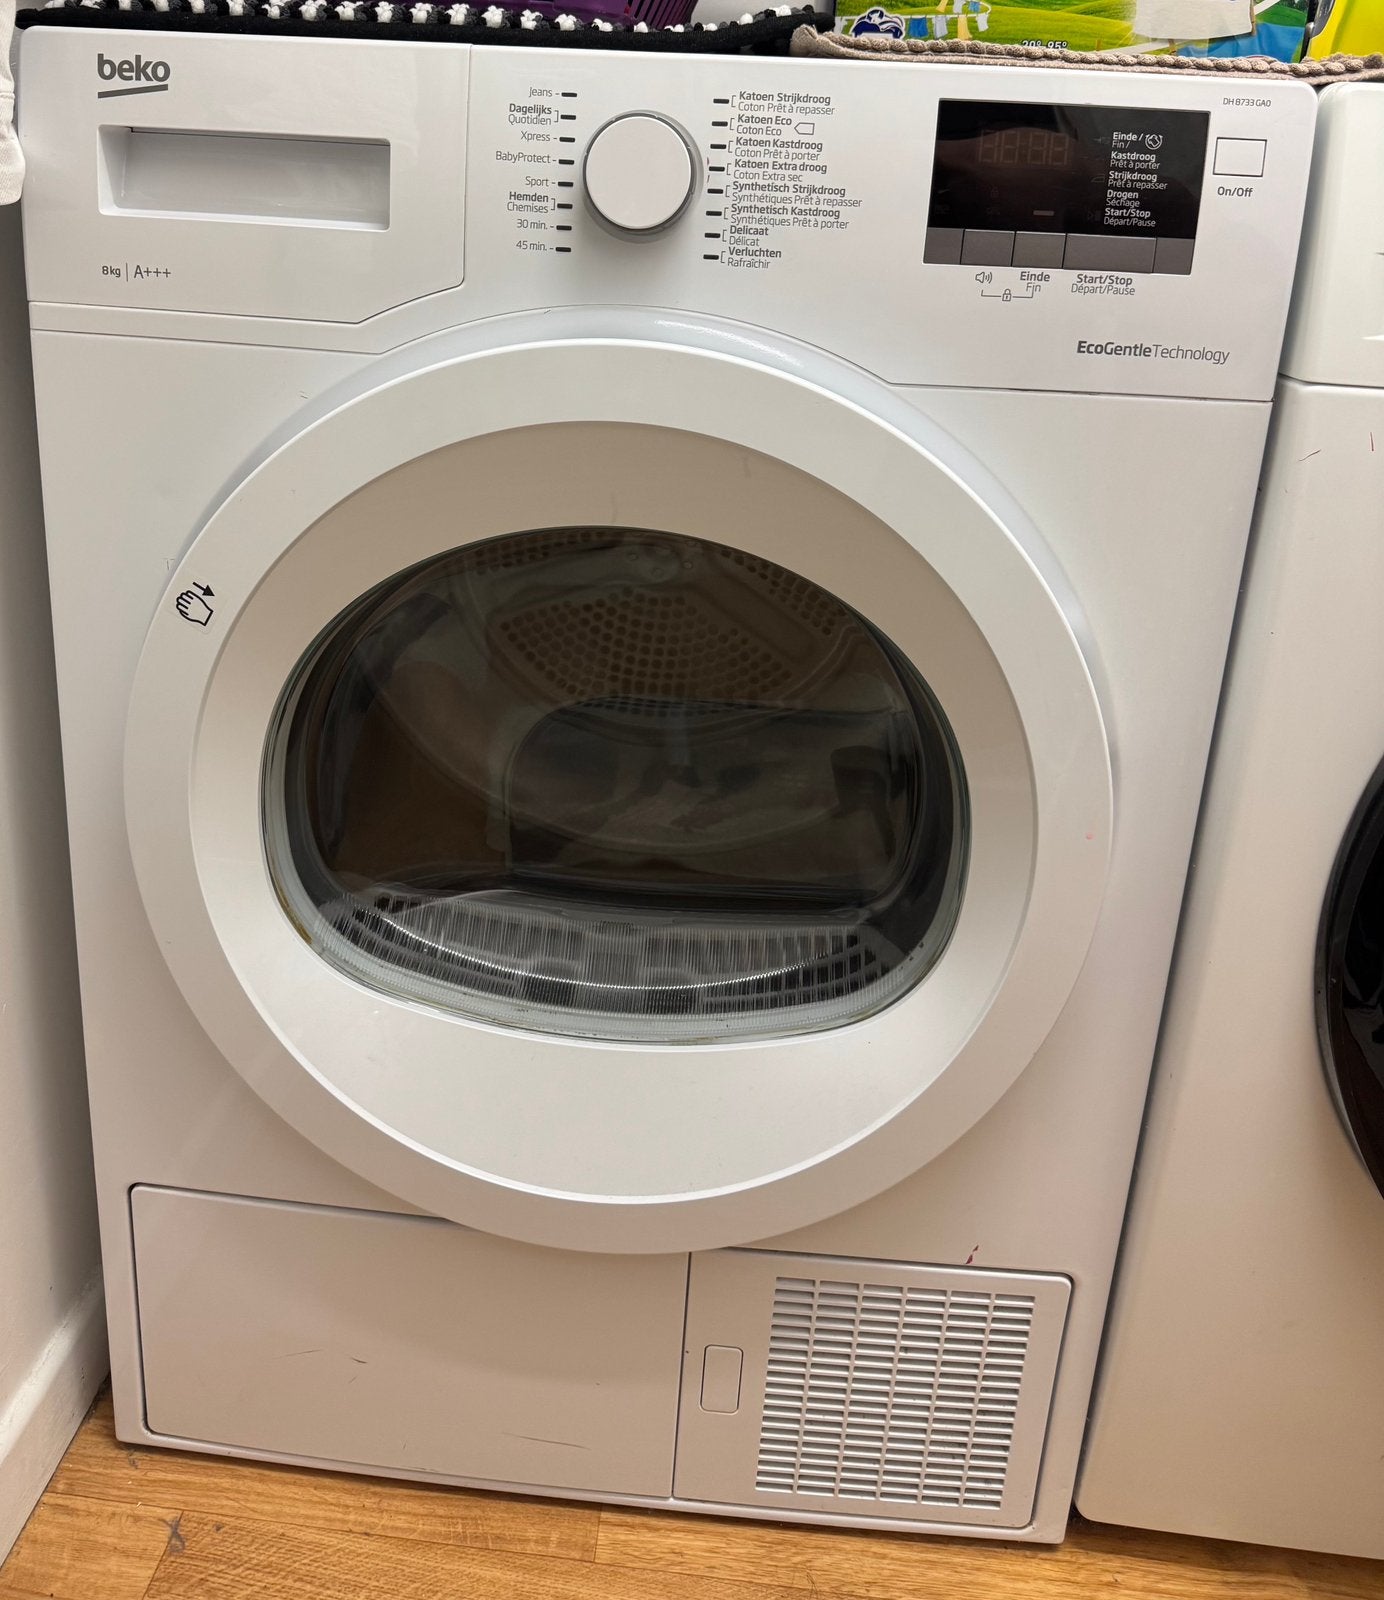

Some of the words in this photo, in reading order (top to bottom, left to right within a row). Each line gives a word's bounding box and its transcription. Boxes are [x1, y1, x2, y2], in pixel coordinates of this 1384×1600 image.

[97, 53, 171, 82] beko
[529, 87, 552, 98] Jeans
[739, 91, 774, 101] Katoen
[777, 93, 831, 106] Strijkdroog
[509, 103, 552, 116] Dagelijks
[738, 102, 764, 112] Coton
[767, 103, 786, 112] Prêt
[788, 105, 794, 113] à
[796, 106, 835, 116] repasser
[508, 114, 551, 125] Quotidien
[737, 114, 773, 125] Katoen
[775, 116, 792, 126] Eco
[736, 125, 764, 135] Coton
[766, 126, 782, 136] Eco
[521, 131, 550, 142] Xpress
[1112, 132, 1137, 141] Einde
[736, 137, 770, 147] Katoen
[772, 139, 823, 152] Kastdroog
[1112, 140, 1124, 148] Fin
[496, 151, 551, 164] BabyProtect
[734, 148, 761, 158] Coton
[763, 149, 783, 159] Prêt
[784, 150, 790, 159] à
[792, 152, 820, 162] porter
[1111, 151, 1156, 162] Kastdroog
[734, 159, 769, 170] Katoen
[772, 161, 797, 171] Extra
[799, 163, 827, 174] droog
[1110, 159, 1127, 168] Prêt
[1128, 160, 1133, 168] à
[1135, 161, 1160, 170] porter
[525, 176, 549, 187] Sport
[733, 170, 759, 180] Coton
[762, 171, 785, 182] Extra
[788, 174, 803, 182] sec
[1109, 171, 1157, 182] Strijkdroog
[732, 181, 789, 193] Synthetisch
[792, 183, 846, 197] Strijkdroog
[1108, 179, 1125, 188] Prêt
[1126, 180, 1132, 188] à
[1133, 182, 1168, 190] repasser
[509, 192, 549, 202] Hemden
[1107, 189, 1138, 200] Drogen
[1217, 186, 1254, 197] On/Off
[732, 192, 792, 205] Synthétiques
[794, 195, 814, 205] Prêt
[815, 196, 820, 206] à
[822, 198, 862, 208] repasser
[1106, 198, 1140, 208] Séchage
[507, 202, 548, 213] Chemises
[731, 204, 788, 215] Synthetisch
[790, 206, 840, 219] Kastdroog
[1105, 208, 1151, 219] Start/Stop
[517, 219, 529, 229] 30
[530, 220, 548, 230] min.
[730, 214, 790, 227] Synthétiques
[792, 216, 812, 227] Prêt
[813, 219, 818, 227] à
[820, 220, 849, 230] porter
[1104, 216, 1156, 227] Départ/Pause
[730, 225, 768, 236] Delicaat
[516, 240, 528, 250] 45
[529, 241, 547, 251] min.
[729, 236, 759, 246] Délicat
[728, 247, 782, 258] Verluchten
[727, 258, 770, 268] Rafraîchir
[134, 265, 171, 279] A+++
[1020, 271, 1050, 282] Einde
[1076, 274, 1133, 286] Start/Stop
[1026, 282, 1041, 292] Fin
[1071, 283, 1135, 295] Départ/Pause
